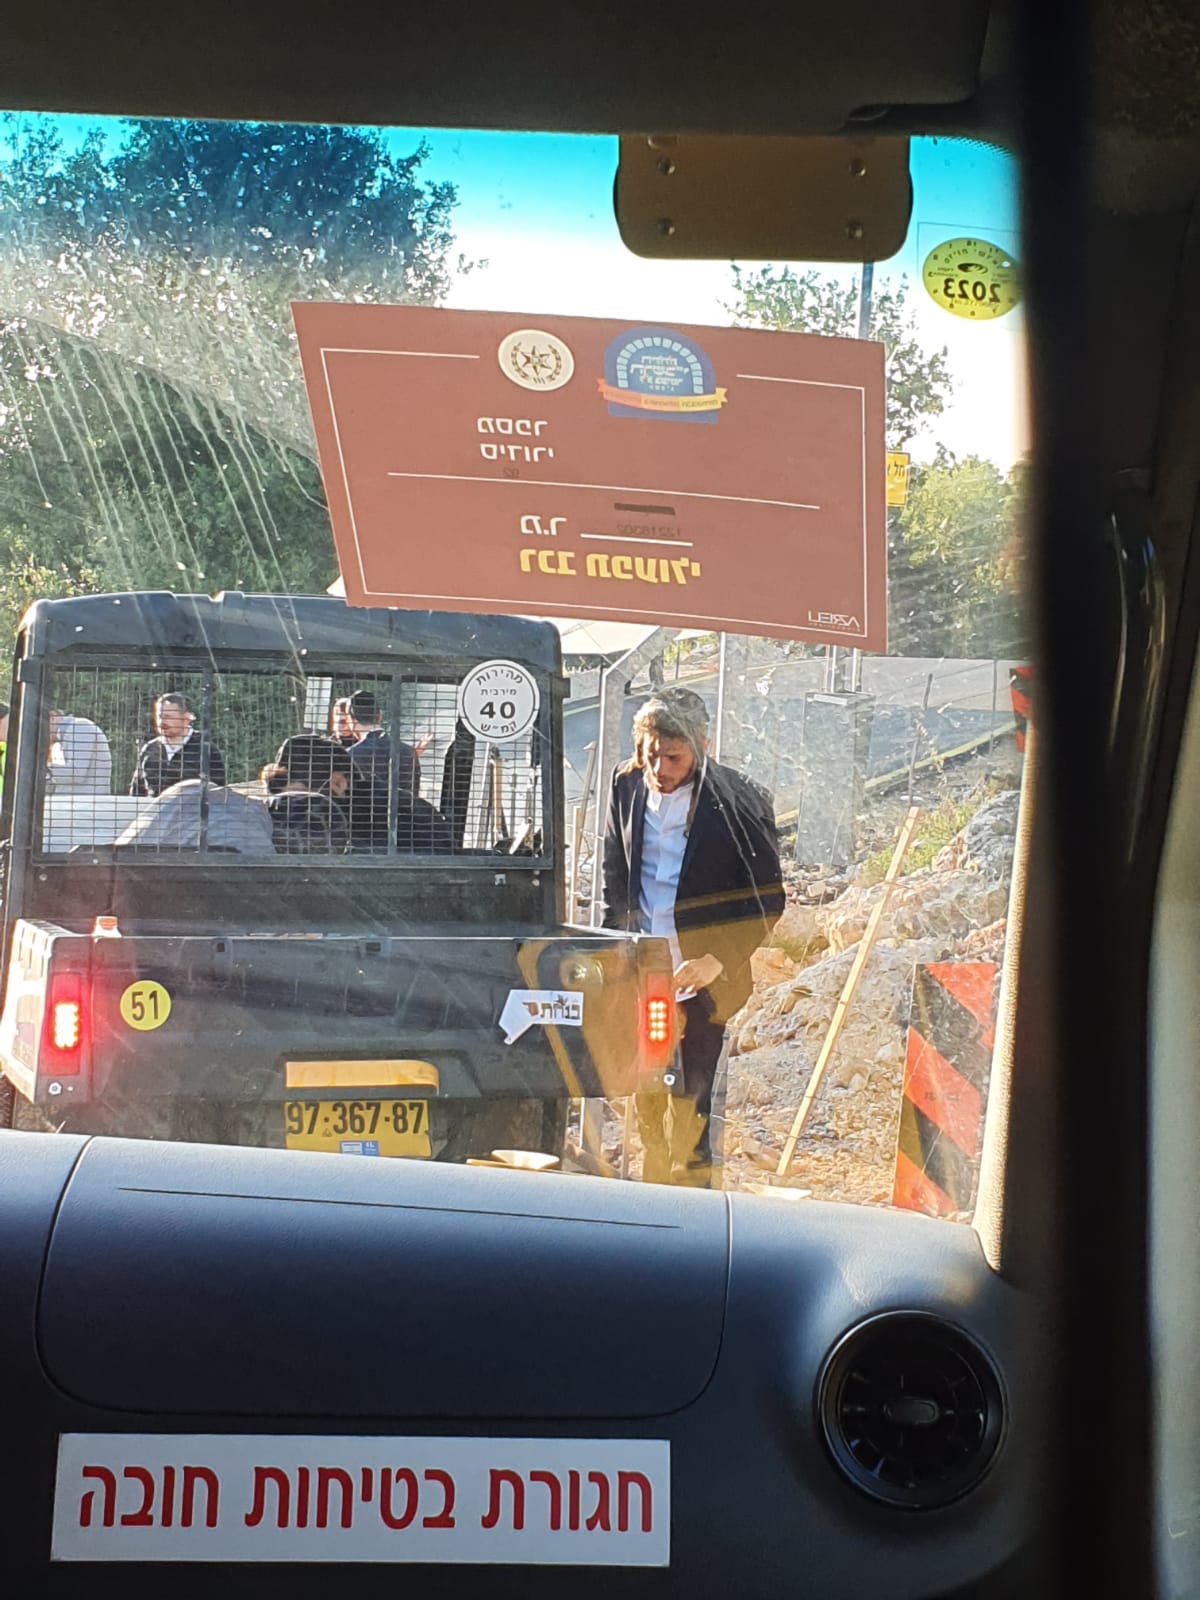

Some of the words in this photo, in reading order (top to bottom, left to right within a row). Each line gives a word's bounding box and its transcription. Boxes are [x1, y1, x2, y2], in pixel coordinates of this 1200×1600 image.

[475, 668, 523, 687] מהירות
[480, 688, 517, 696] מירבית
[479, 701, 516, 719] 40
[131, 989, 159, 1021] 51
[79, 1465, 219, 1528] חובה
[244, 1465, 456, 1530] בטיחות
[481, 1467, 654, 1533] חגורת
